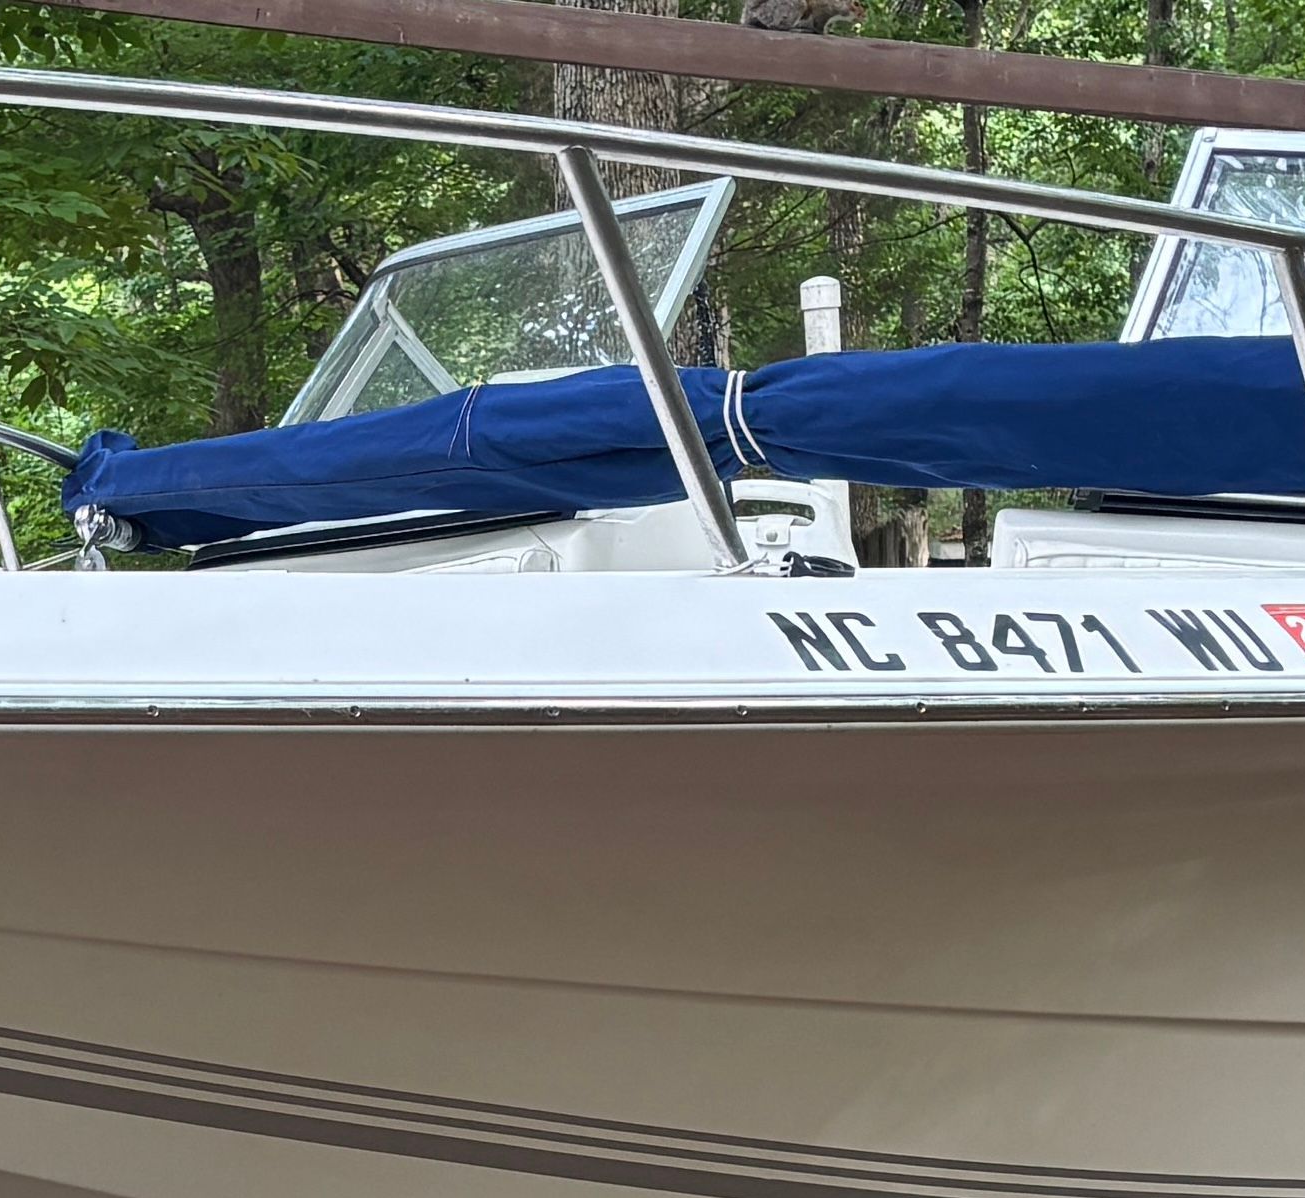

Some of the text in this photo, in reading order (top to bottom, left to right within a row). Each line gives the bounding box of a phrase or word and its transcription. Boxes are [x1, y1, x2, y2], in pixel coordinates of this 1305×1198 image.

[768, 609, 1284, 673] NC 8471 WU
